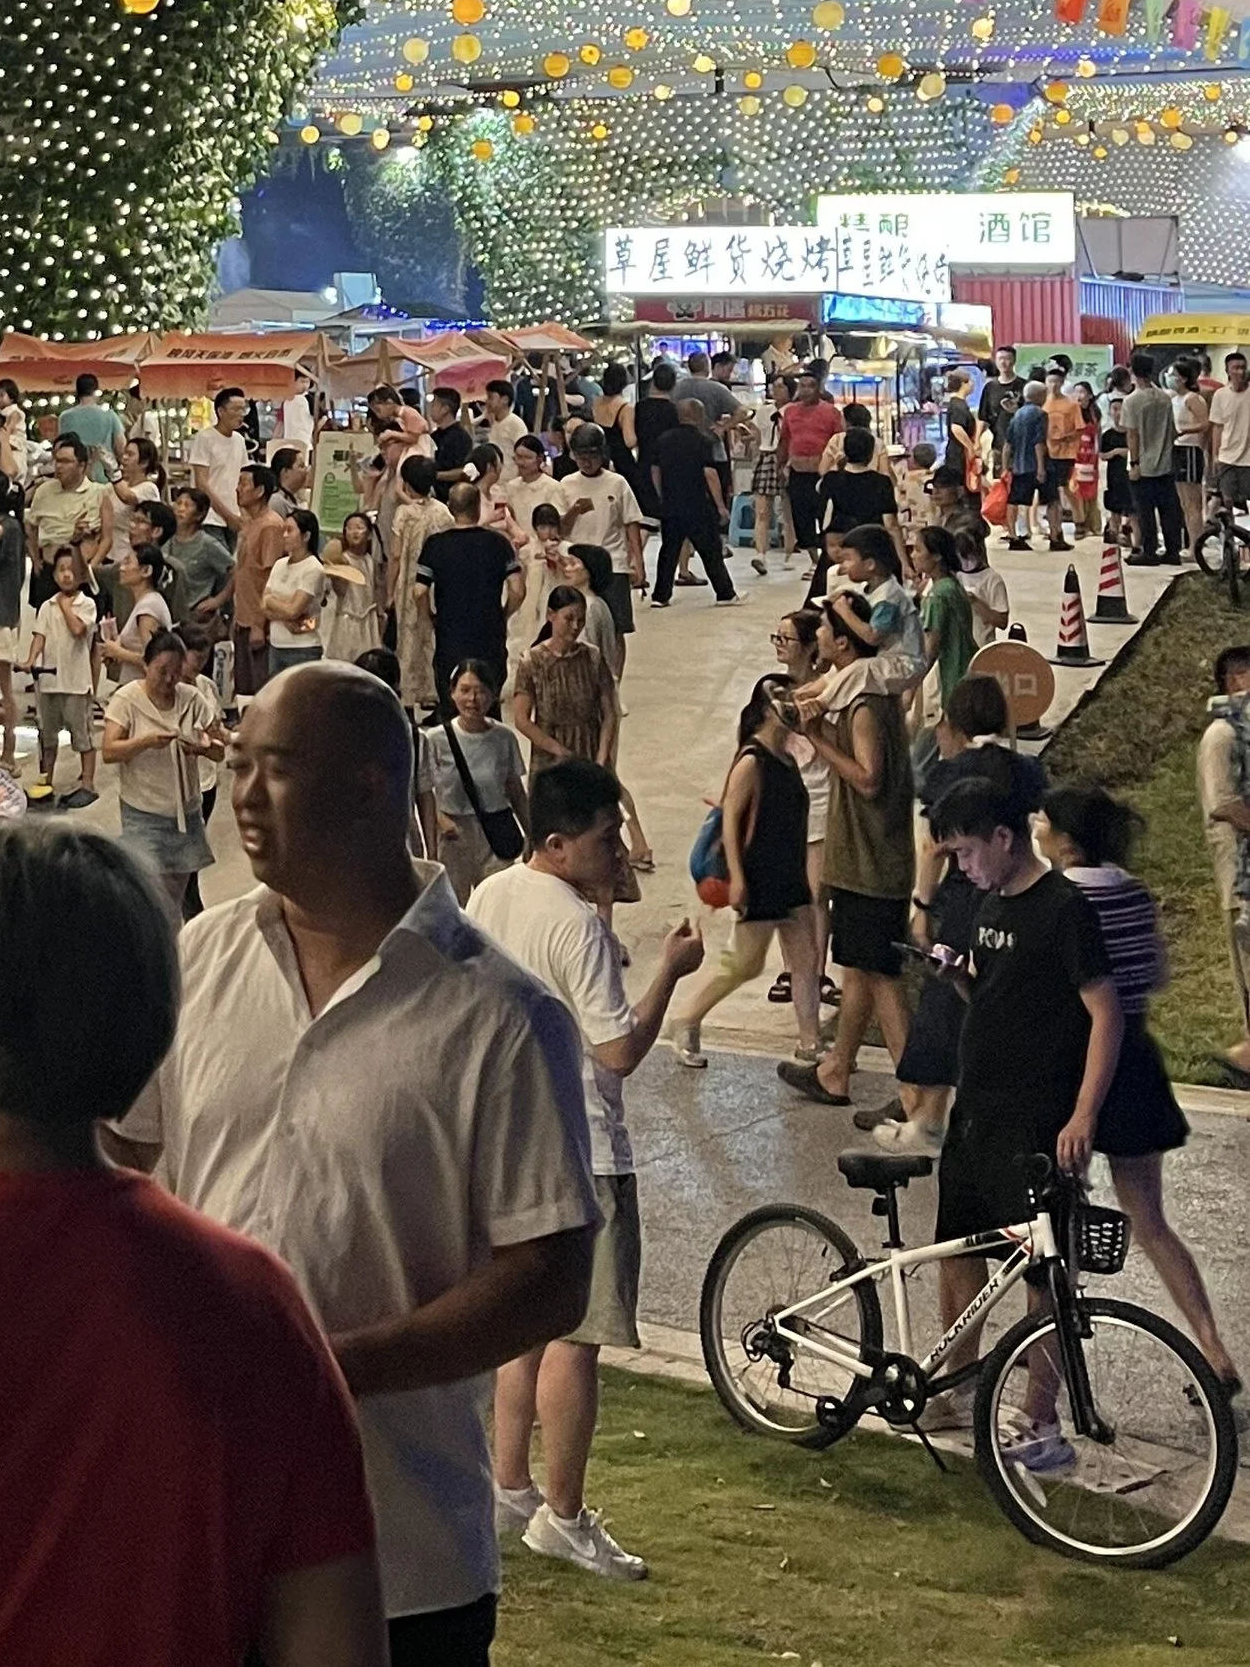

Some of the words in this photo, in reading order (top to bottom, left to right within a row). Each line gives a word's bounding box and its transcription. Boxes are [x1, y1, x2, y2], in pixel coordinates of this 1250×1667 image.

[979, 211, 1052, 244] 酒馆
[609, 233, 836, 285] 草屋鲜货烧烤
